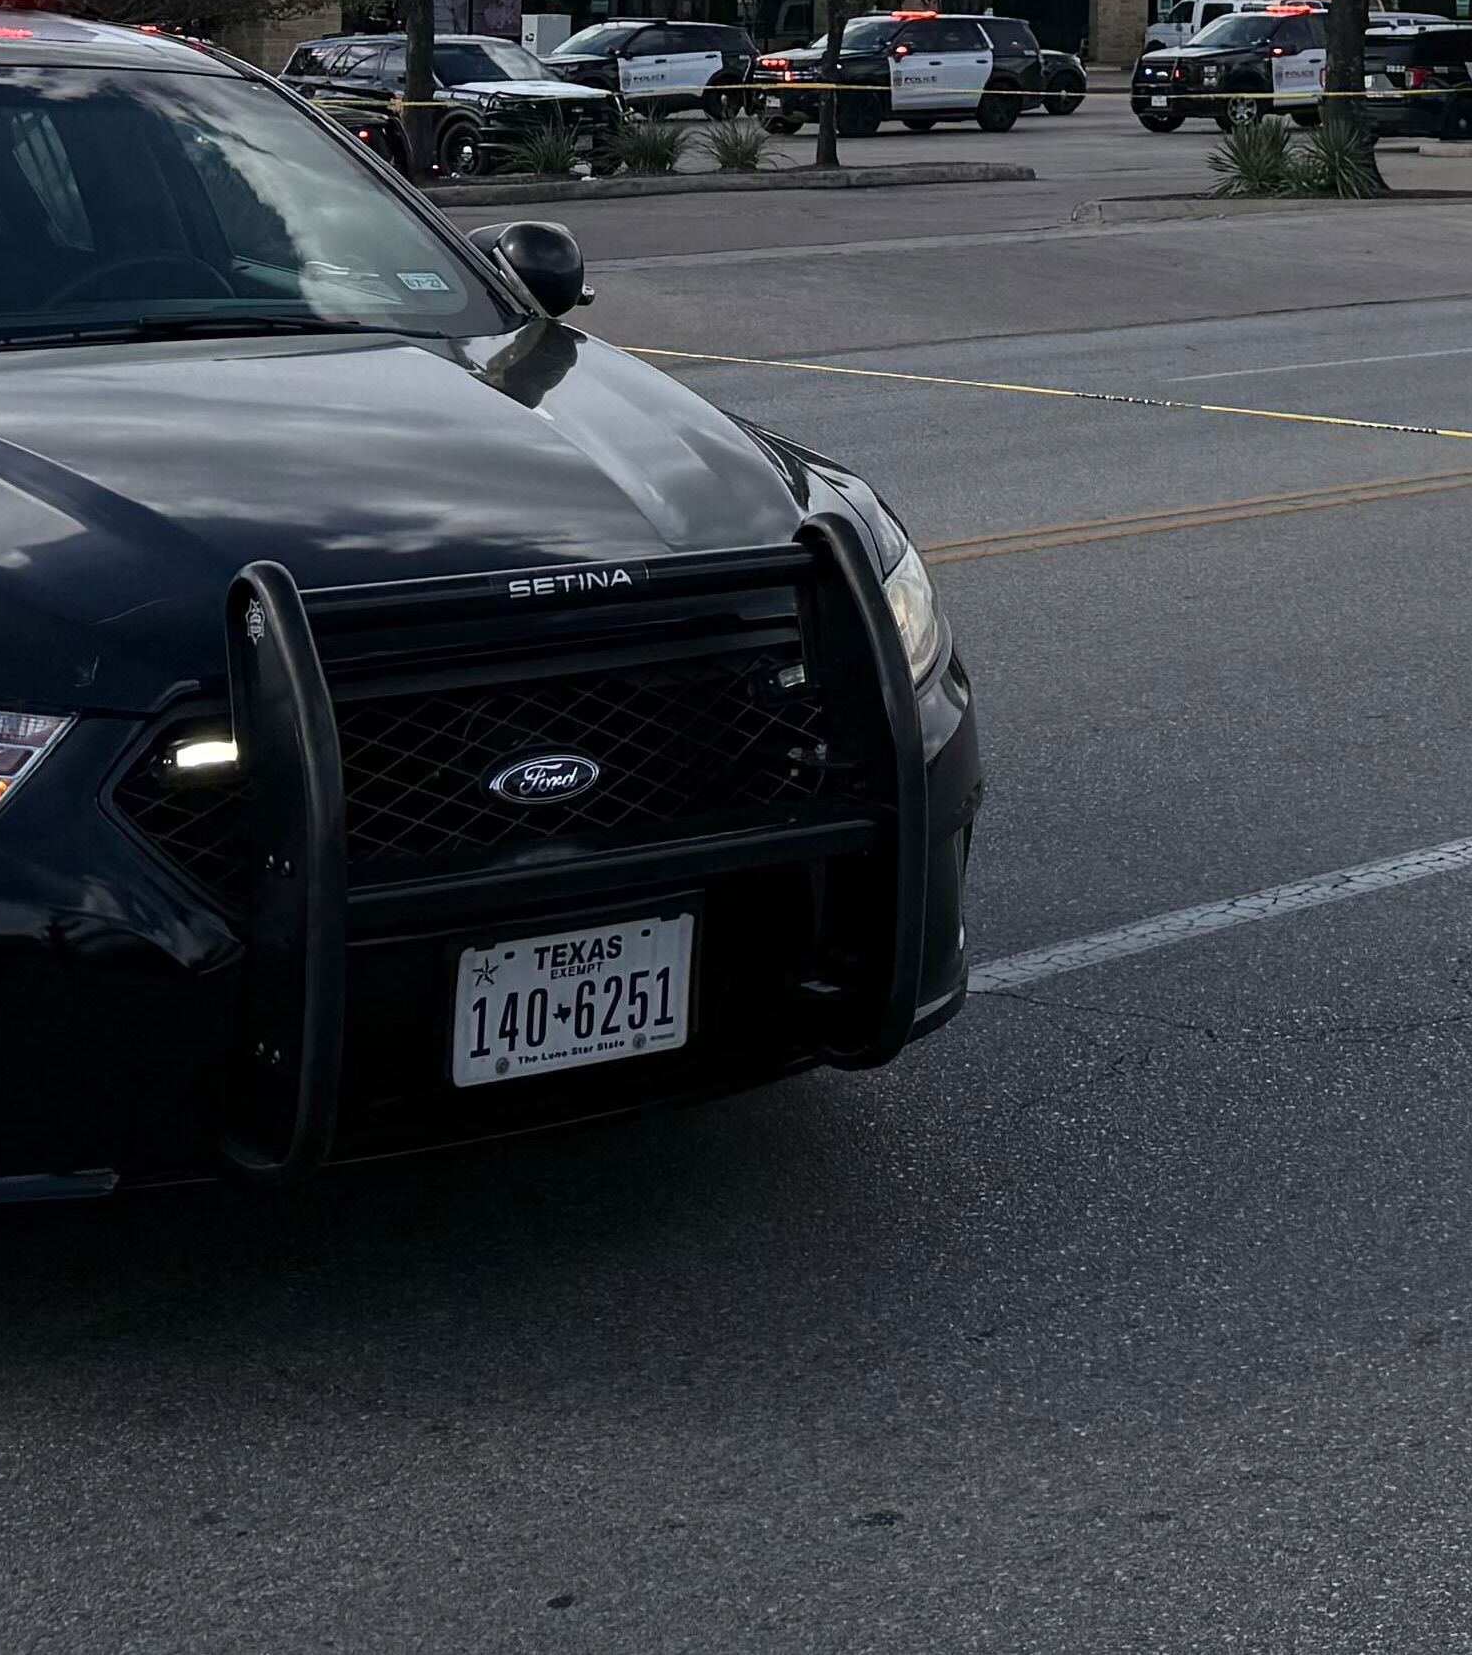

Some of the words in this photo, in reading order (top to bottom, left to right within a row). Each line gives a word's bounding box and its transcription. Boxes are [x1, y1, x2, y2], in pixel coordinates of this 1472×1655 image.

[508, 568, 633, 599] SETINA
[519, 763, 580, 795] Ford
[533, 934, 623, 971] TEXAS
[549, 961, 605, 981] EXEMPT
[517, 1054, 539, 1065] The
[541, 1050, 568, 1062] Lone
[571, 1045, 594, 1056] Star
[597, 1039, 625, 1052] State
